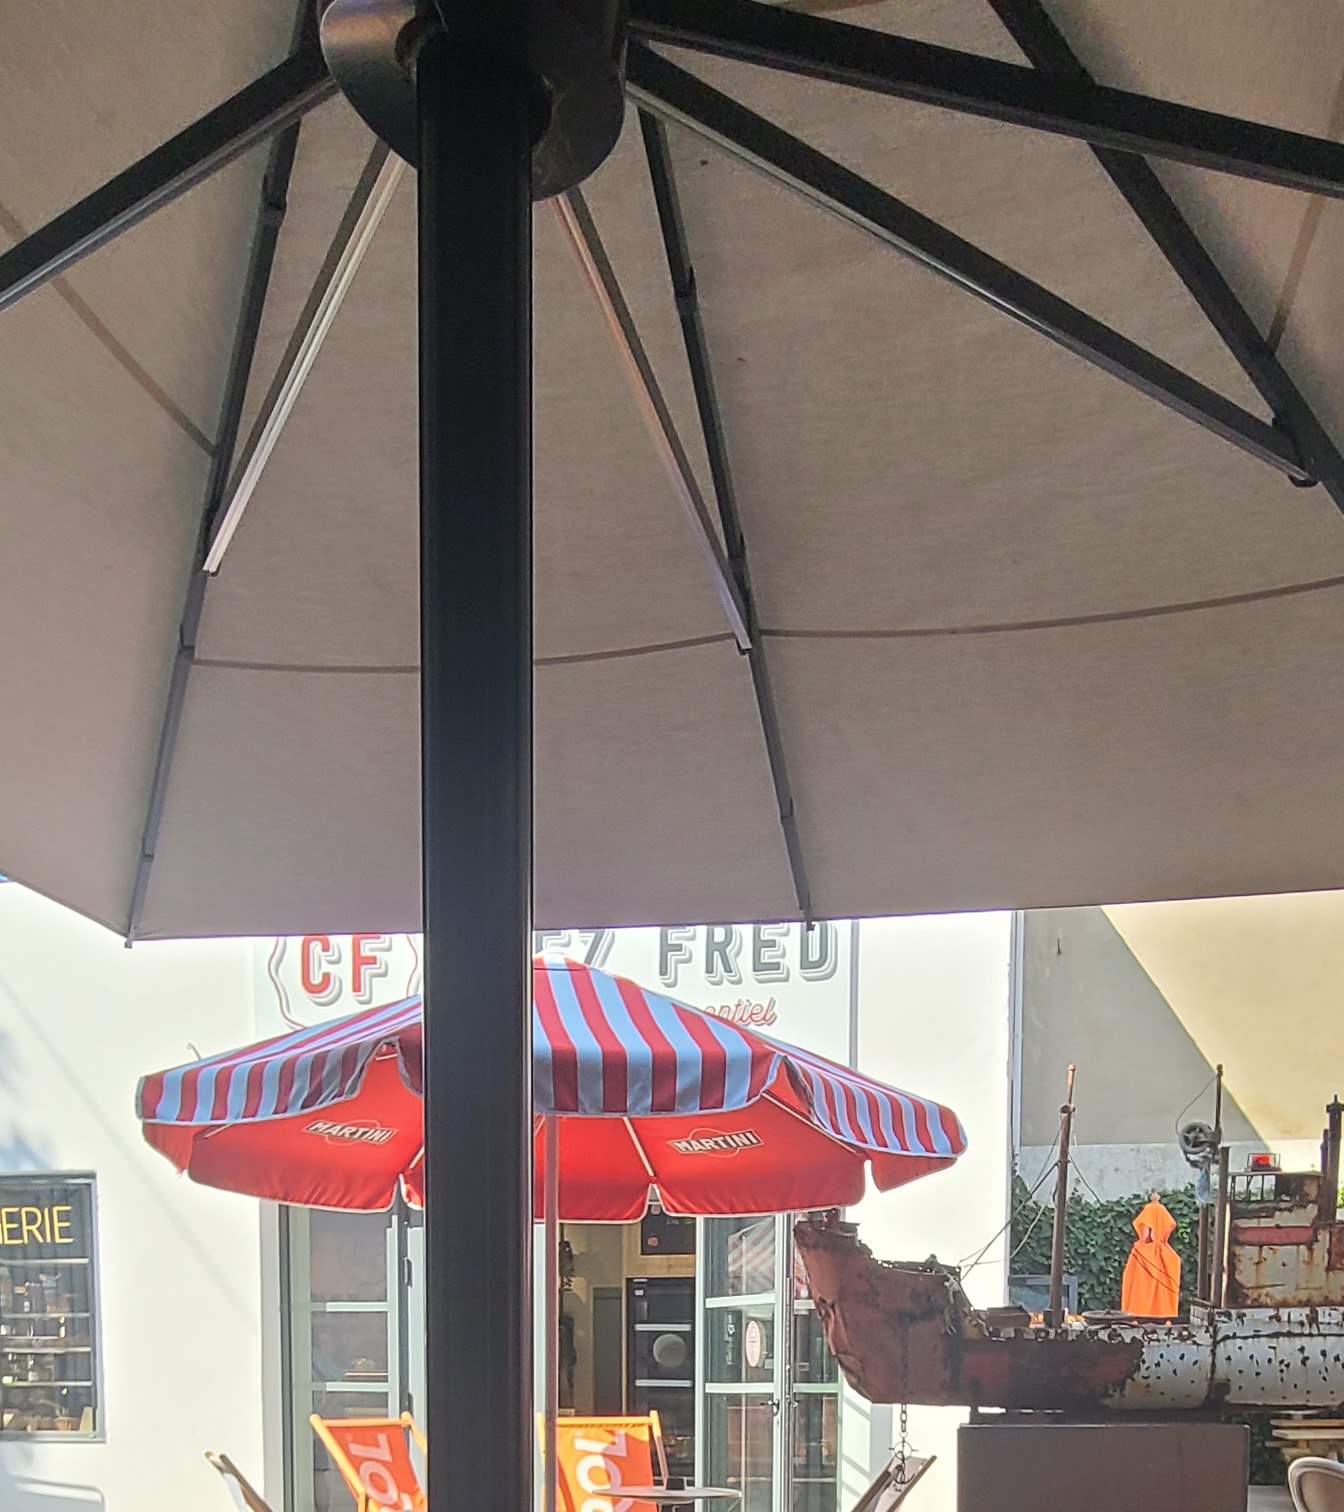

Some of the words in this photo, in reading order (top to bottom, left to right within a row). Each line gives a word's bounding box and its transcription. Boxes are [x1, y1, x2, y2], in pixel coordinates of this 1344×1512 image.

[659, 922, 836, 986] FRED
[307, 1121, 393, 1143] MARTINI
[673, 1131, 759, 1152] MARTINI
